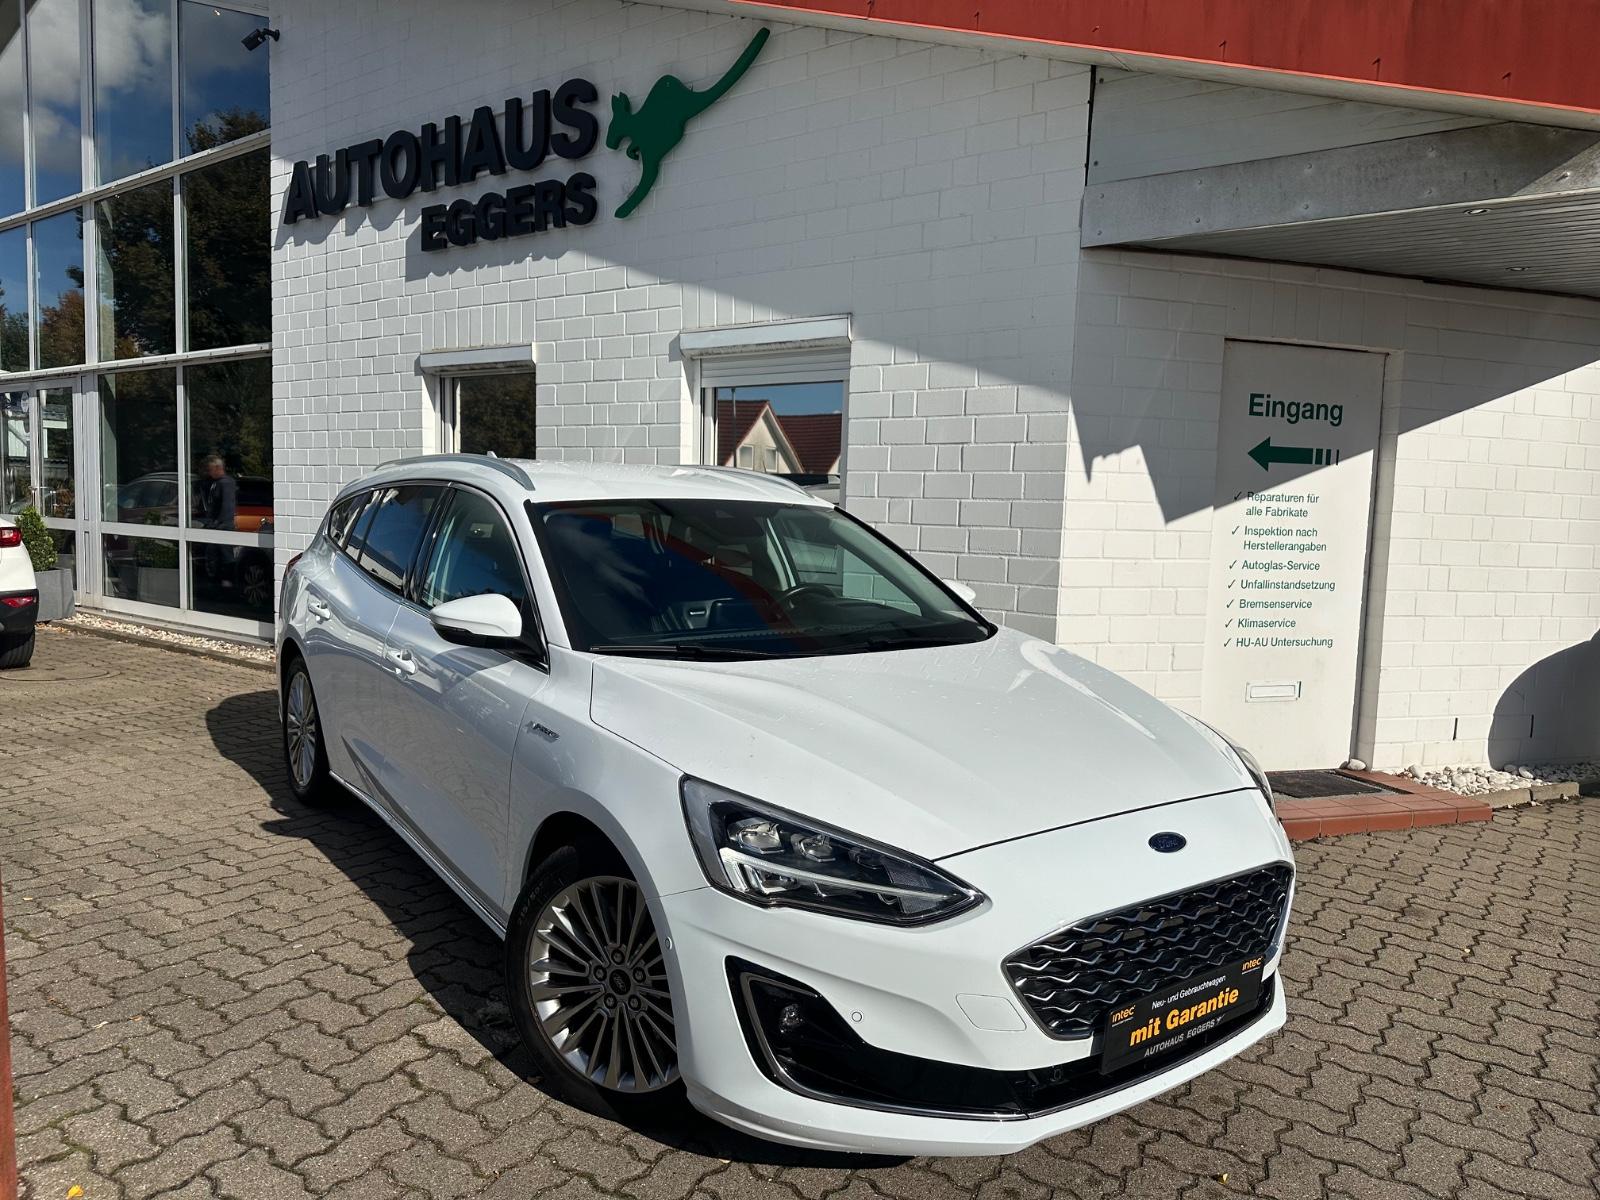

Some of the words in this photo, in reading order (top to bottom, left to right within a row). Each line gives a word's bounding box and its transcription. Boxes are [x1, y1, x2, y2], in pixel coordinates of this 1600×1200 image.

[283, 78, 598, 224] AUTOHAUS
[421, 172, 597, 251] EGGERS
[1248, 392, 1344, 427] Eingang
[1247, 491, 1304, 504] Reparaturen
[1306, 493, 1320, 503] für
[1245, 506, 1263, 516] alle
[1265, 506, 1308, 517] Fabrikate
[1244, 525, 1293, 538] Inspektion
[1295, 528, 1318, 537] nach
[1243, 540, 1327, 553] Herstellerangaben
[1241, 559, 1321, 572] Autoglas-Service
[1240, 579, 1336, 592] Unfallinstandsetzung
[1239, 598, 1313, 609] Bremsenservice
[1237, 617, 1297, 628] Klimaservice
[1236, 638, 1269, 647] HU-AU
[1270, 637, 1334, 648] Untersuchung
[1242, 956, 1263, 971] intec
[1151, 999, 1167, 1010] Neu-
[1167, 991, 1179, 1007] und
[1179, 975, 1227, 999] Gebrauchtwagen
[1111, 1005, 1135, 1023] intec
[1129, 1016, 1161, 1047] mit
[1165, 987, 1239, 1030] Garantie
[1144, 1033, 1185, 1058] AUTOHAUS
[1186, 1018, 1215, 1039] EGGERS
